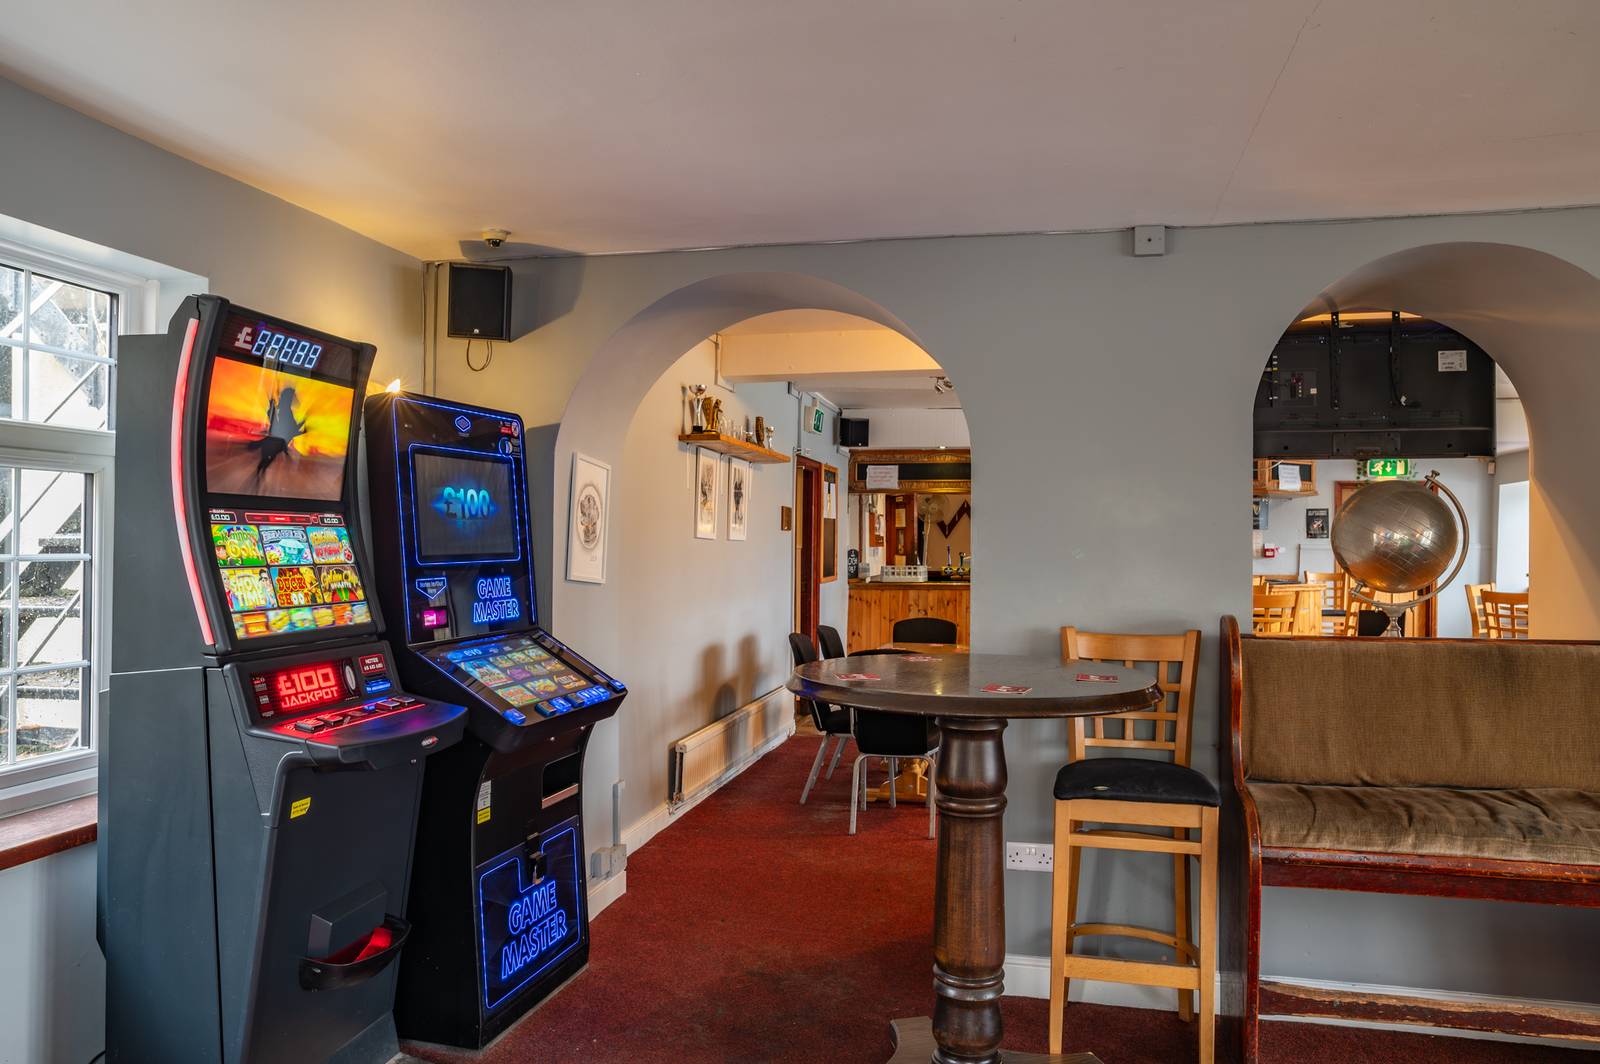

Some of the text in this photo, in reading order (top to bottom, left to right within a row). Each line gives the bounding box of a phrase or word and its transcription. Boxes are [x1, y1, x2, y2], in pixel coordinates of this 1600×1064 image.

[441, 486, 492, 520] £100
[276, 576, 307, 592] DUCK
[477, 577, 511, 599] GAME
[277, 590, 310, 607] SHOOT
[473, 599, 520, 623] MASTER
[463, 648, 483, 657] evo
[278, 667, 336, 695] £100
[281, 687, 338, 709] JACKPOT
[509, 881, 557, 935] GAME
[501, 910, 567, 979] MASTER
